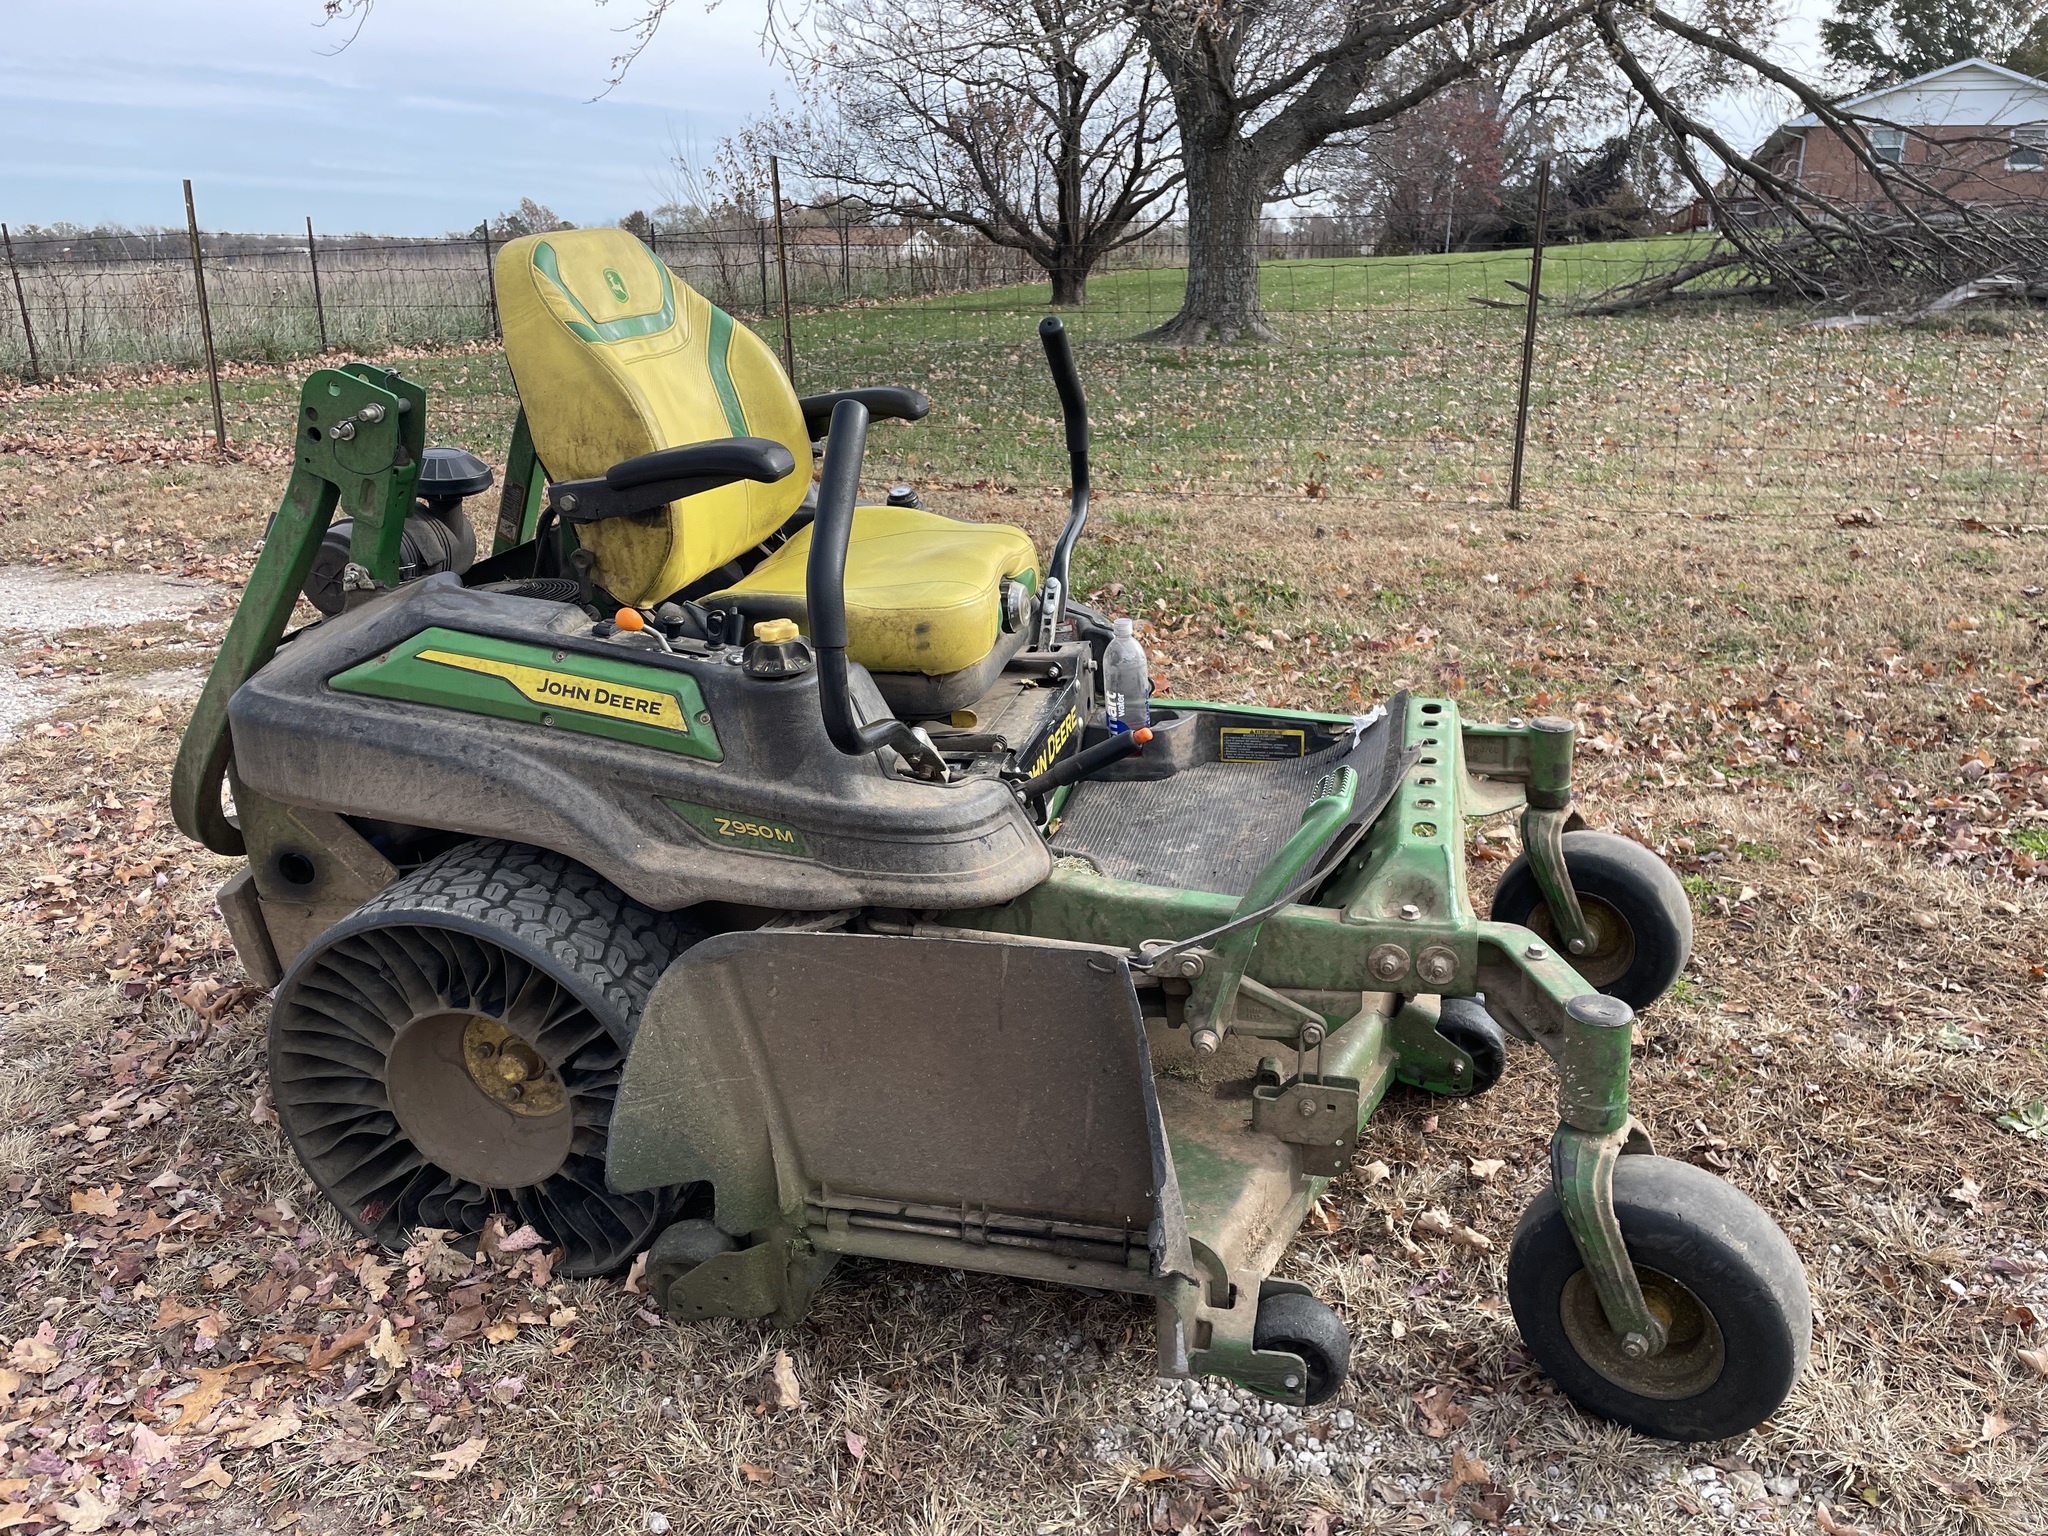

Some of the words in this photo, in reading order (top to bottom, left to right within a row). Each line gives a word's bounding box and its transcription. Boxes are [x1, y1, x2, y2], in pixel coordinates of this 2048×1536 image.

[537, 678, 590, 701] JOHN
[594, 688, 662, 715] DEERE
[1106, 690, 1118, 737] mart
[1117, 692, 1126, 718] water
[1028, 749, 1048, 778] HN
[1047, 704, 1077, 765] DEERE
[714, 817, 795, 843] Z950M
